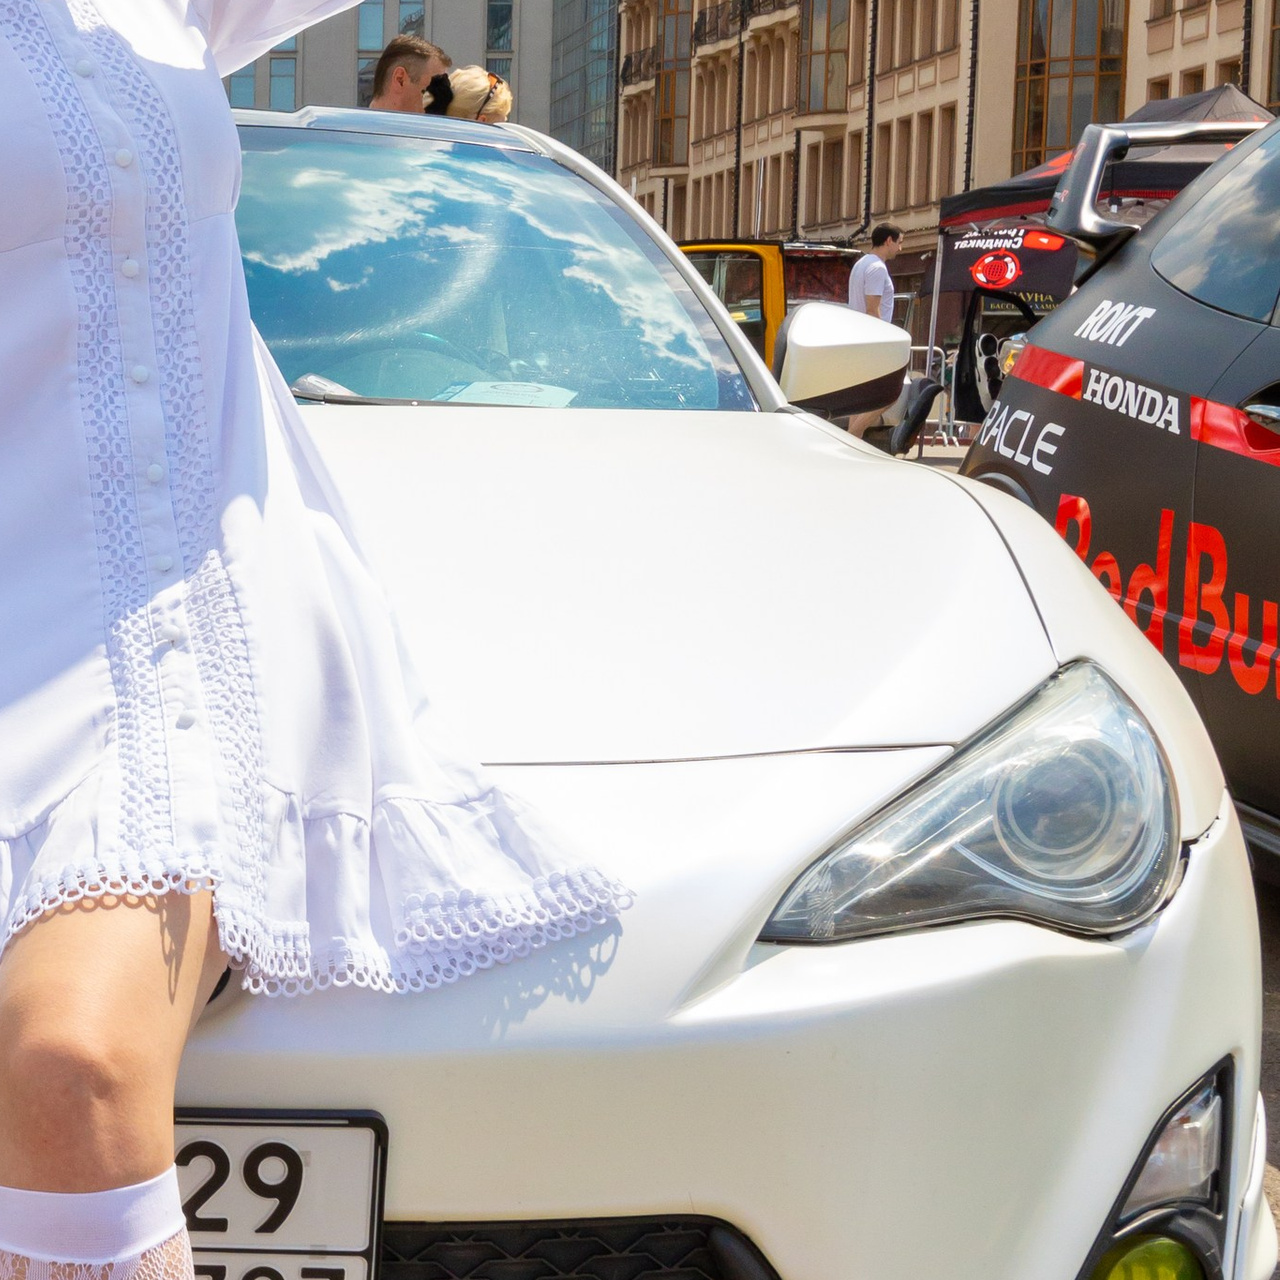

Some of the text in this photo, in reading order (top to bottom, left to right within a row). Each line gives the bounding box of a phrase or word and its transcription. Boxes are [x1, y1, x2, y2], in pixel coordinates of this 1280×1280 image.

[1009, 291, 1053, 303] АУНА
[1074, 299, 1156, 347] ROKT
[1082, 368, 1180, 435] HONDA
[1178, 521, 1280, 701] Bu
